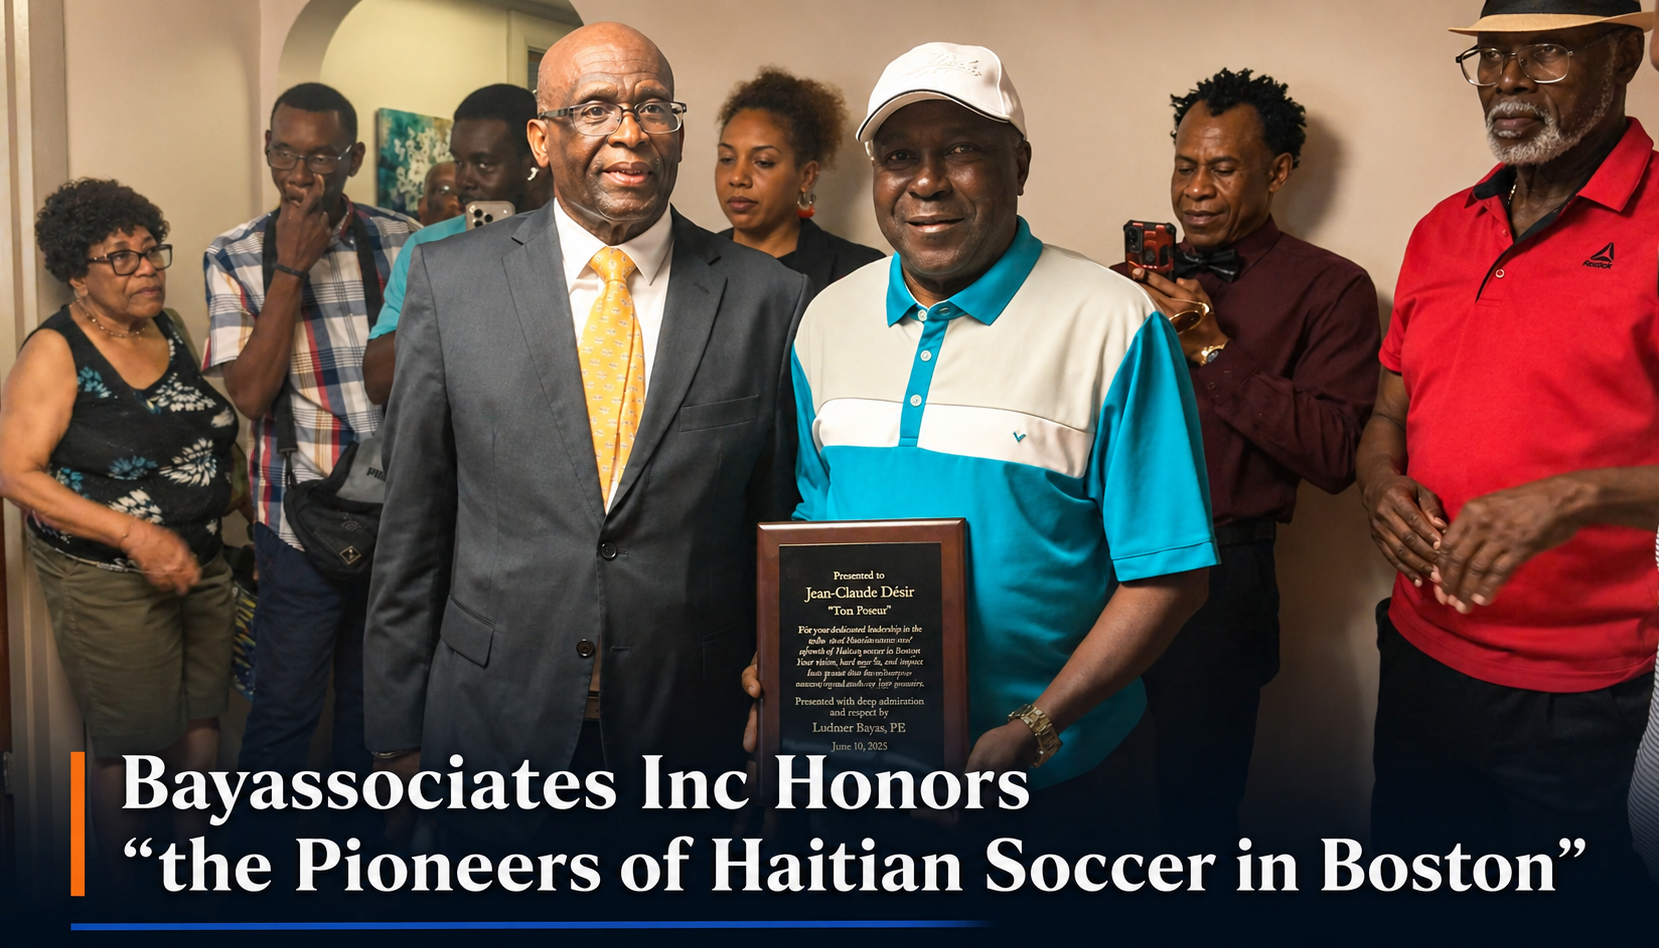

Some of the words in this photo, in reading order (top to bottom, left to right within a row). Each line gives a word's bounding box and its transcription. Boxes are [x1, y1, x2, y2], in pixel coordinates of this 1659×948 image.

[833, 571, 874, 580] Presented
[876, 572, 885, 580] to
[804, 586, 878, 602] Jean-Claude
[880, 586, 915, 598] Désir
[828, 605, 854, 616] "Ton
[856, 605, 892, 616] Poseur"
[798, 625, 812, 634] For
[813, 627, 830, 636] your
[912, 625, 923, 633] the
[826, 647, 835, 656] of
[795, 697, 835, 706] Presented
[836, 697, 855, 706] with
[857, 697, 877, 708] deep
[879, 697, 925, 706] admiration
[830, 708, 846, 716] and
[848, 709, 877, 718] respect
[879, 708, 889, 718] by
[812, 722, 854, 733] Ludmer
[856, 723, 888, 735] Bayas,
[890, 722, 906, 733] PE
[831, 741, 852, 752] June
[854, 742, 866, 751] 10,
[868, 742, 888, 751] 2025
